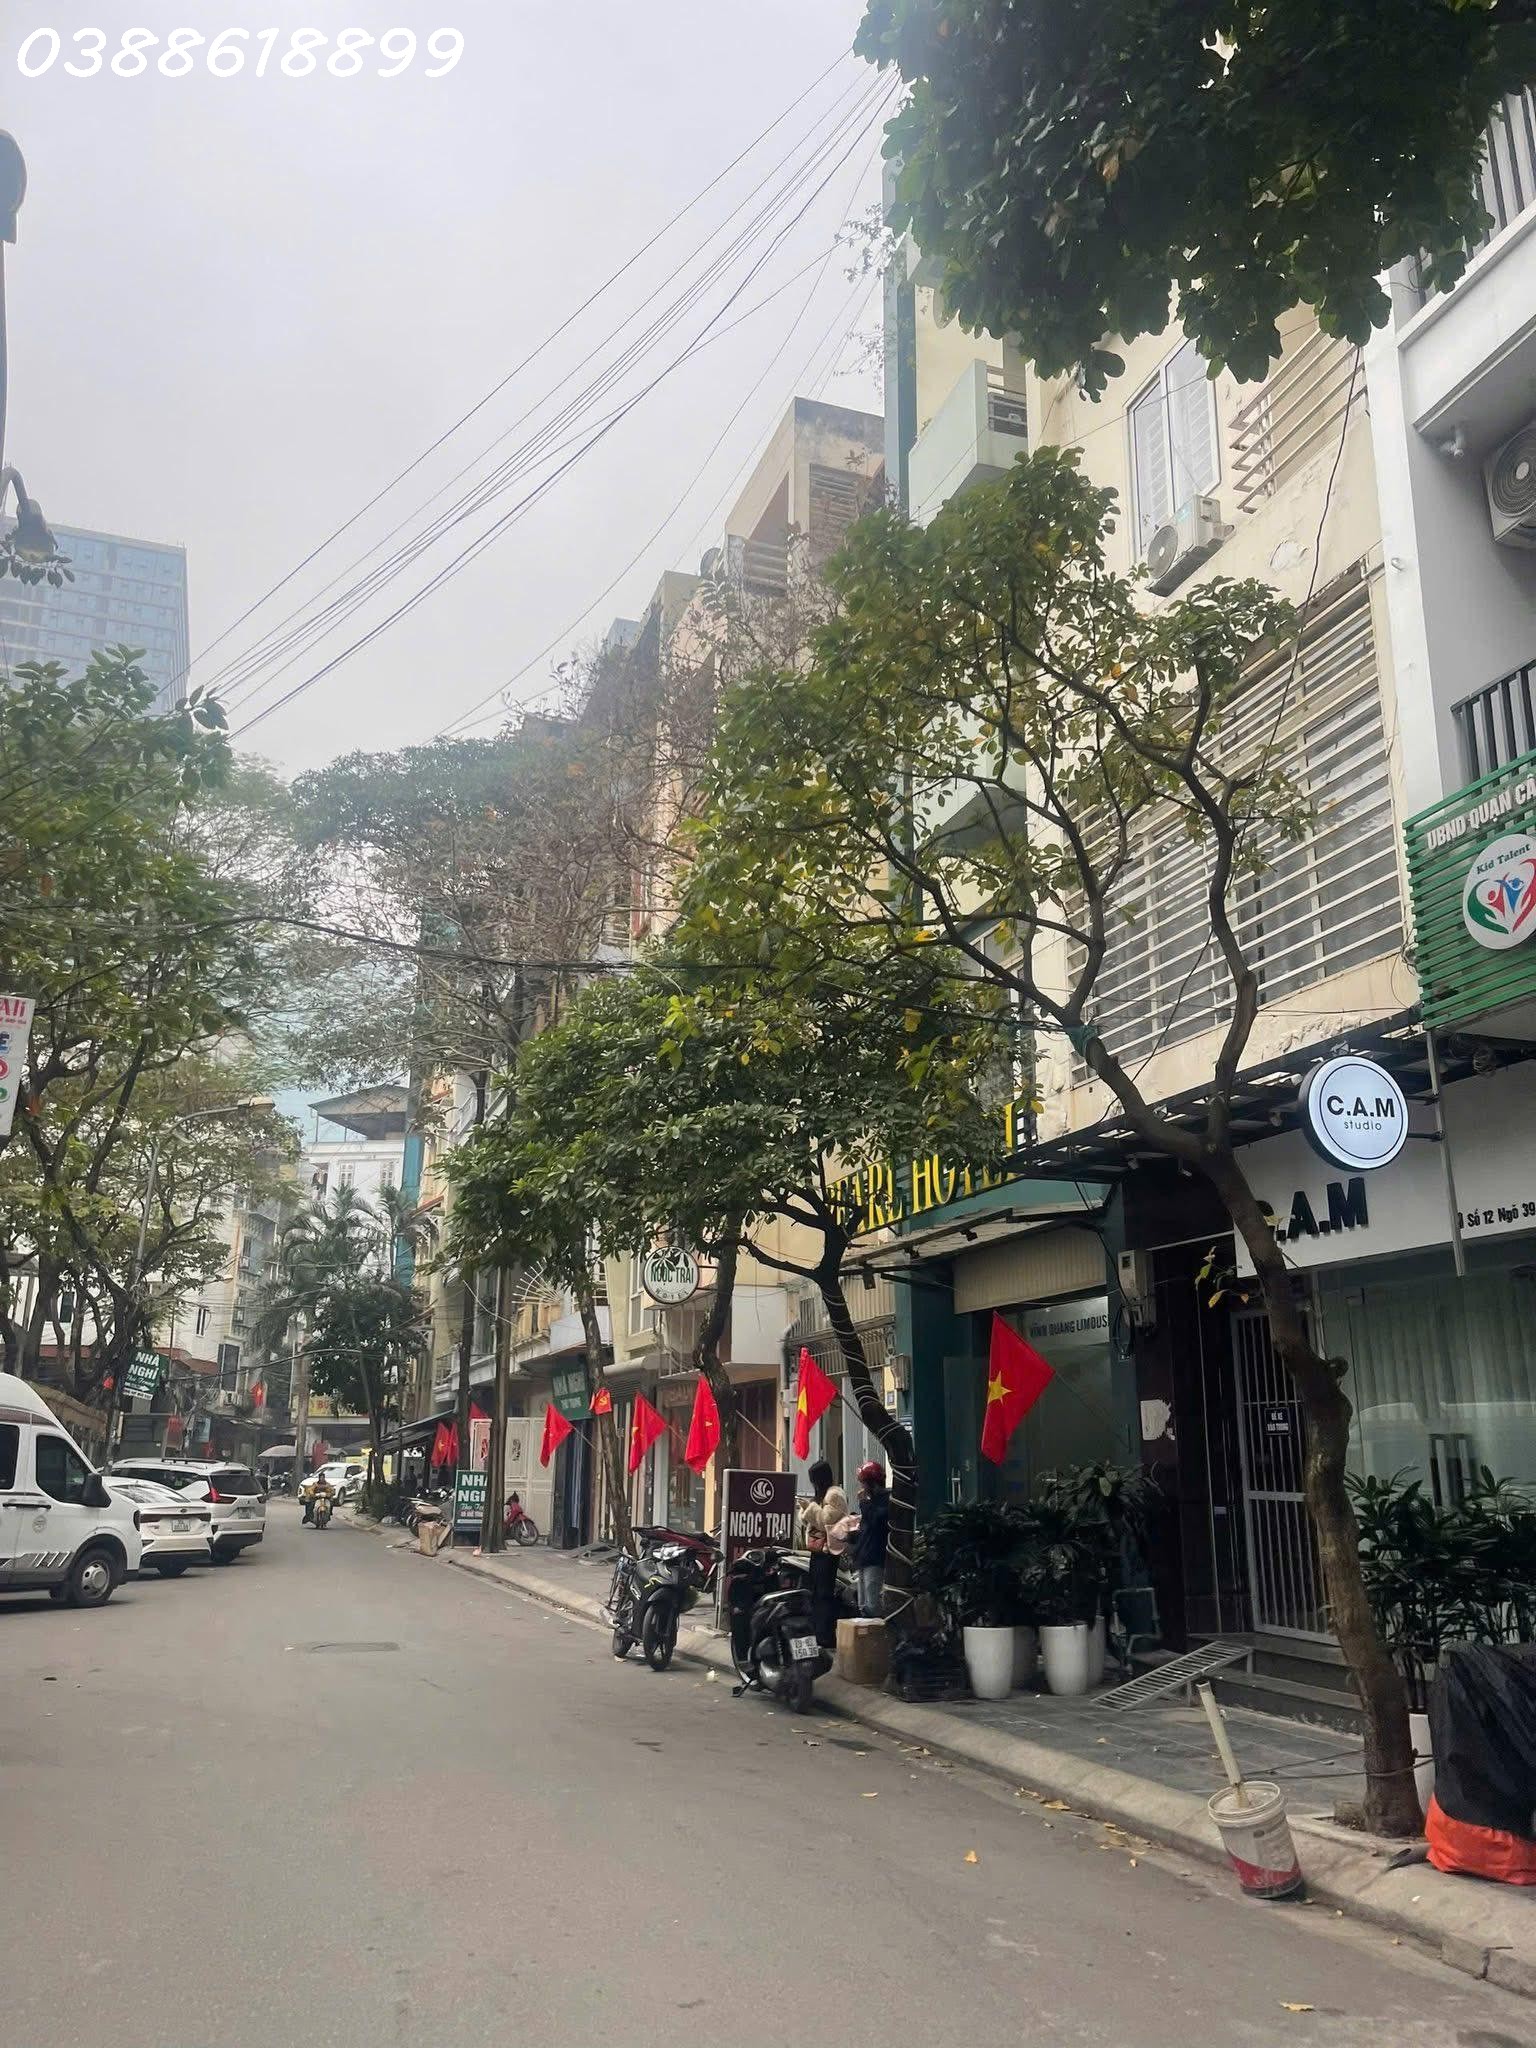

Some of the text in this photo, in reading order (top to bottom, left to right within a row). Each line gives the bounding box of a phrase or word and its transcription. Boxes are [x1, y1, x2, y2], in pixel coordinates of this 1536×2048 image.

[1426, 815, 1467, 850] UBND
[1476, 843, 1532, 875] Kid Talent
[1326, 1095, 1395, 1118] C.A.M
[1343, 1120, 1382, 1130] studio
[1467, 1208, 1481, 1227] Số
[1483, 1210, 1495, 1225] 12
[1497, 1204, 1519, 1223] Ngõ
[675, 1267, 694, 1284] TRAI
[729, 1511, 792, 1543] NGỌC TRAI
